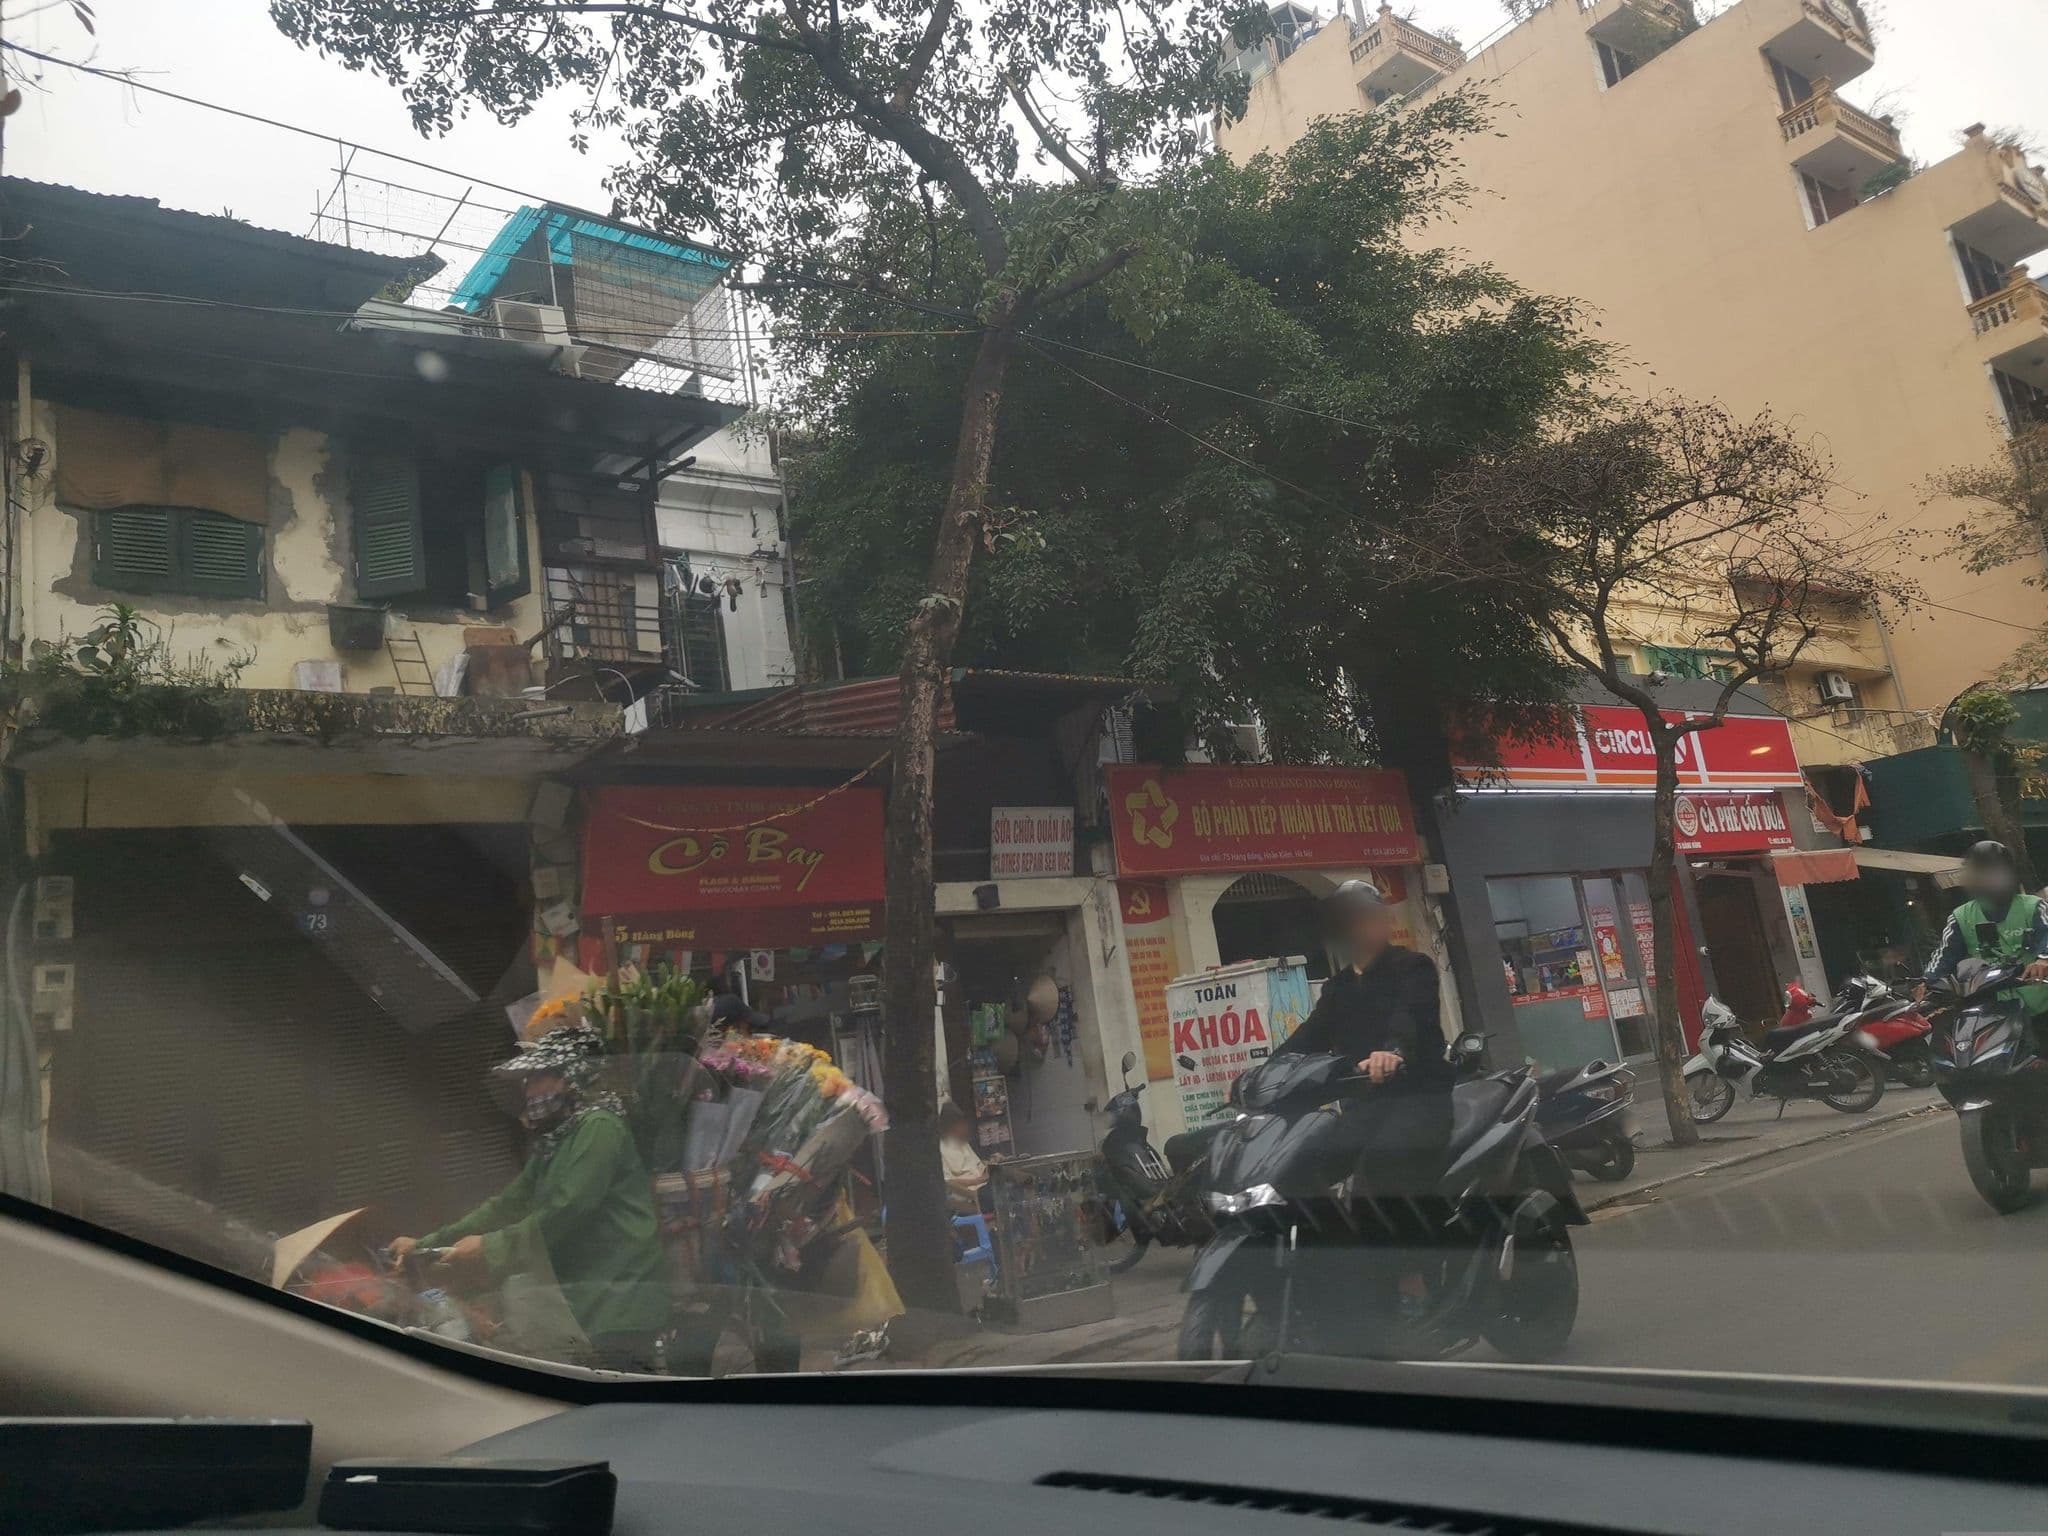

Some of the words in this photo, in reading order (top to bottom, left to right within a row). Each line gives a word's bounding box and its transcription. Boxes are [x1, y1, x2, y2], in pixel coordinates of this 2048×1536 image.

[1192, 800, 1211, 843] BỘ
[1213, 800, 1249, 842] PHẬN
[1250, 796, 1276, 835] TIẾP
[1279, 799, 1315, 841] NHẬN
[1315, 799, 1332, 833] VÀ
[1357, 796, 1378, 833] KẾT
[1700, 800, 1718, 832] CÀ
[1716, 798, 1741, 832] PHÊ
[1740, 794, 1762, 831] CỐT
[1761, 798, 1786, 831] DỪA
[745, 826, 826, 892] Bay
[307, 914, 327, 929] 73
[615, 926, 628, 942] 5
[632, 929, 664, 943] Hàng
[666, 927, 696, 941] Bông
[1195, 983, 1236, 1003] TOÀN
[1173, 1004, 1267, 1053] KHÓA
